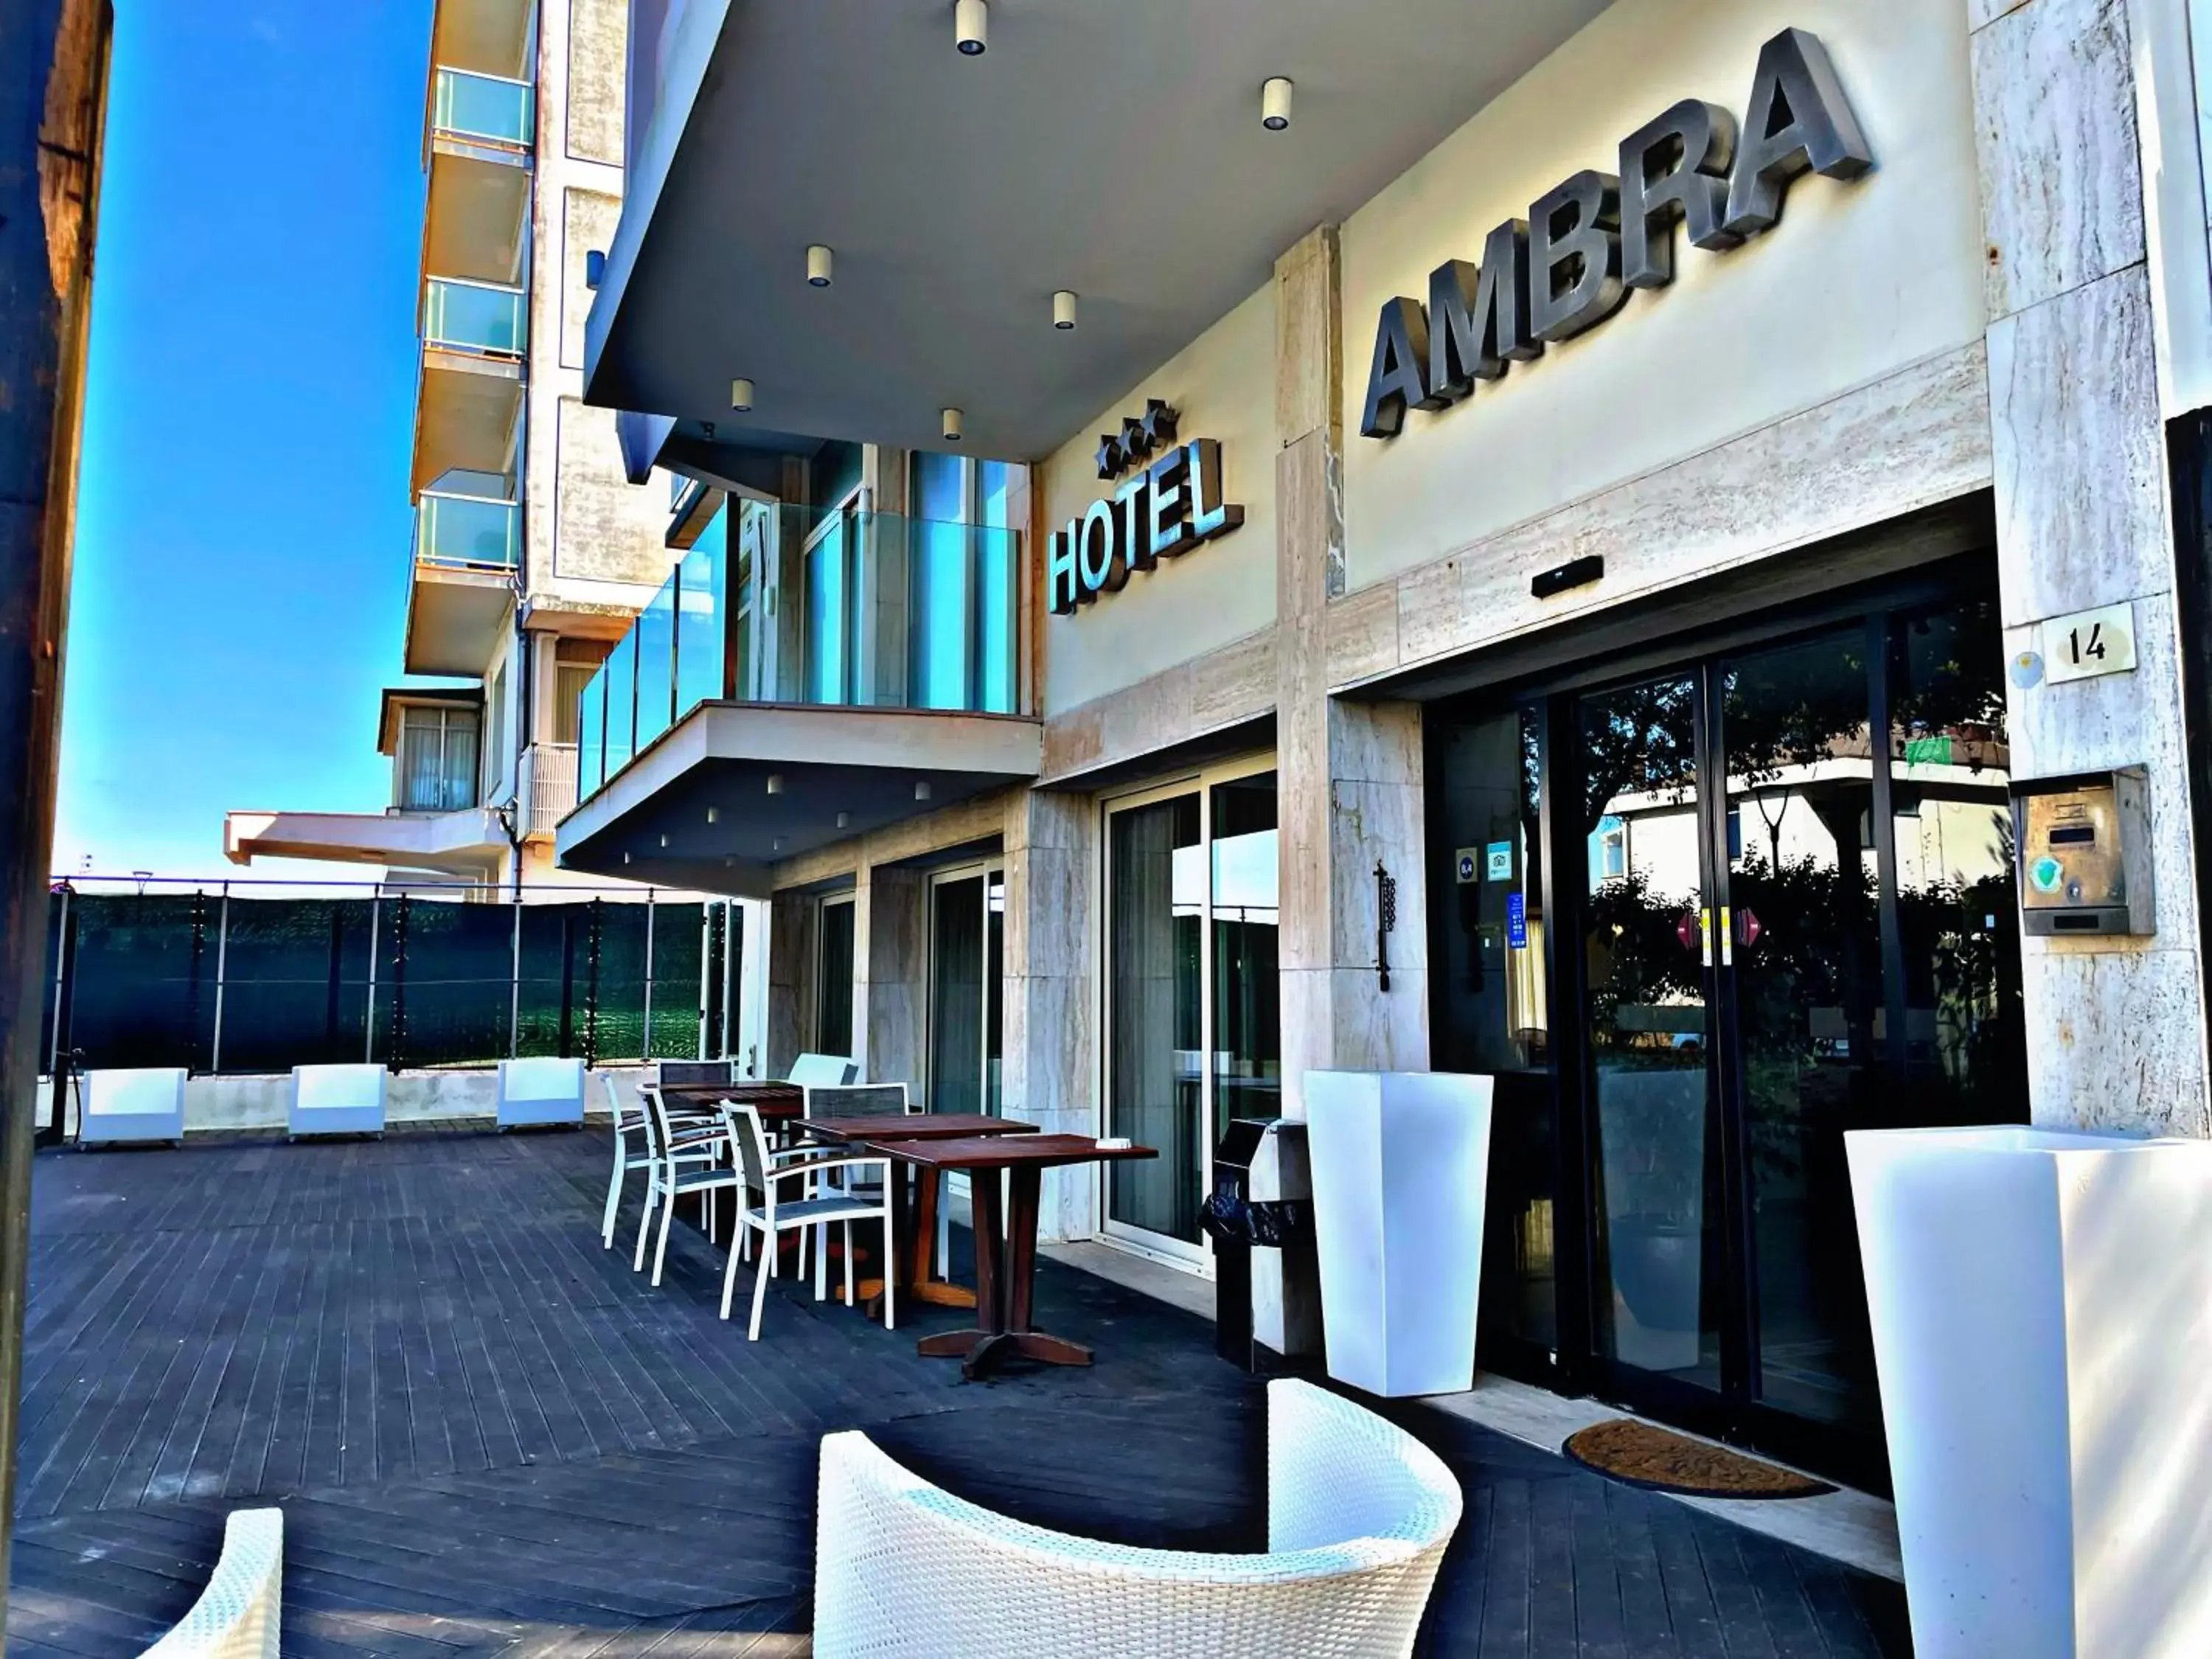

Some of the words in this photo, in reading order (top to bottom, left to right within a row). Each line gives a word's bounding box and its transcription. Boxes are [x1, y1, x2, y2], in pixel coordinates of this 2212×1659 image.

[1360, 27, 1874, 439] AMBRA
[1048, 438, 1240, 614] HOTEL
[2070, 622, 2106, 664] 14
